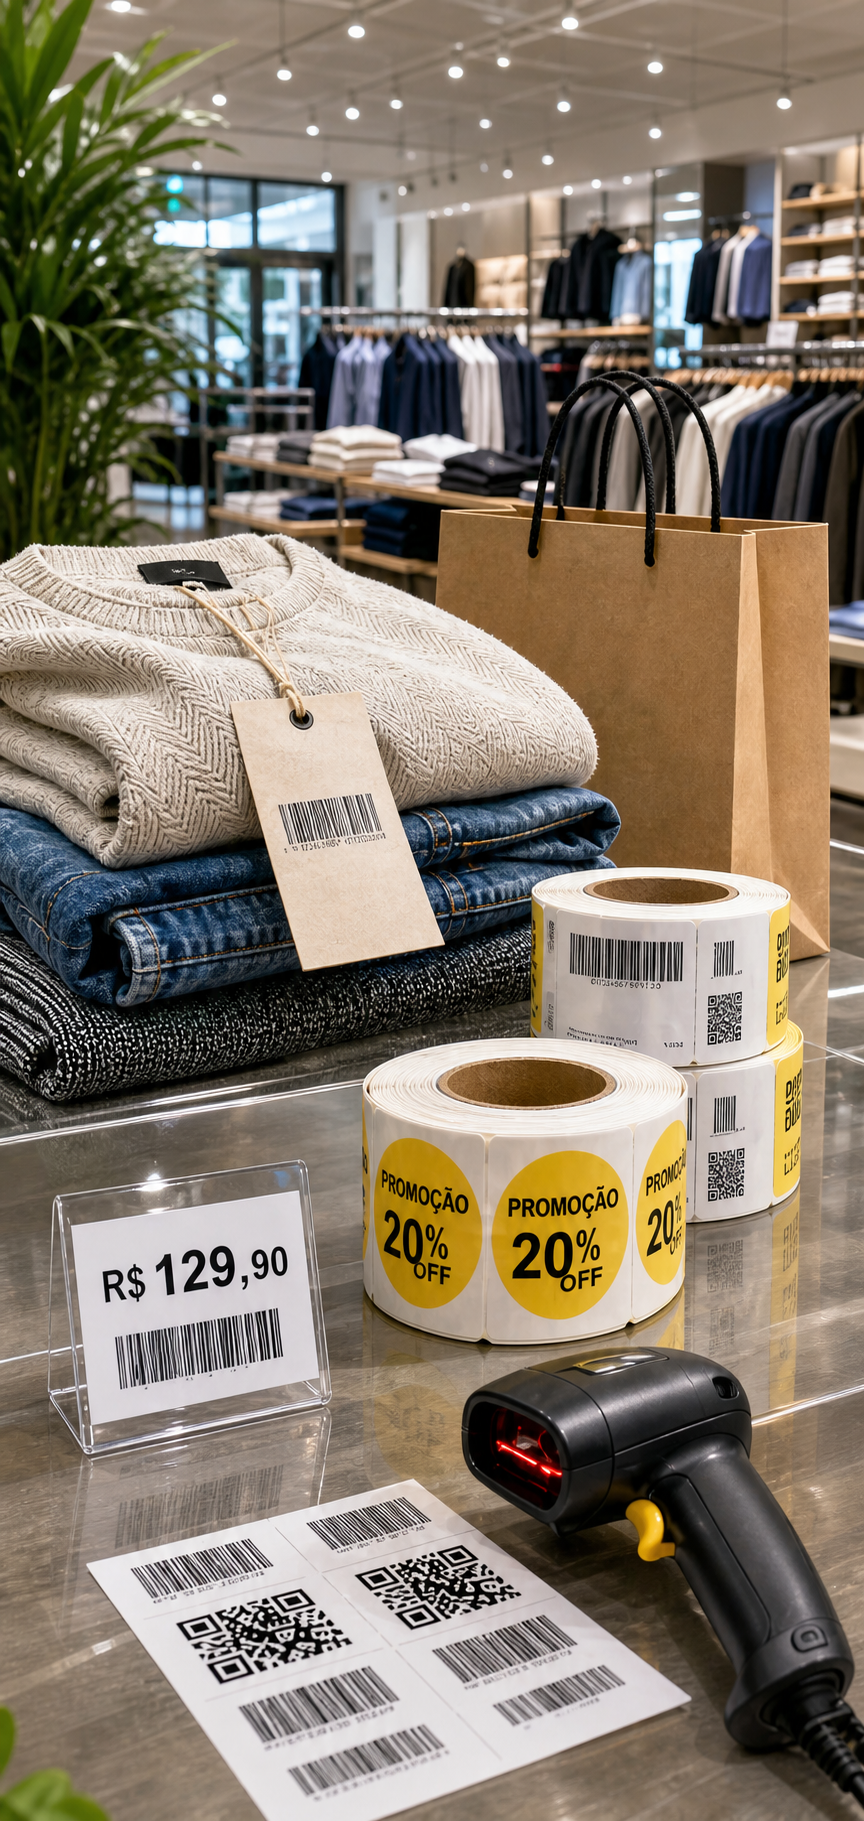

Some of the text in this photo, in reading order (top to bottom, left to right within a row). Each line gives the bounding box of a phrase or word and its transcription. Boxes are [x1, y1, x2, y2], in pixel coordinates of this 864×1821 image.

[381, 1169, 470, 1215] PROMOÇÃO
[508, 1185, 619, 1219] PROMOÇÃO
[383, 1209, 449, 1265] 20%
[646, 1191, 683, 1257] 20%
[102, 1245, 288, 1303] R$ 129,90
[413, 1262, 452, 1285] OFF
[512, 1227, 601, 1280] 20%
[559, 1266, 603, 1292] OFF
